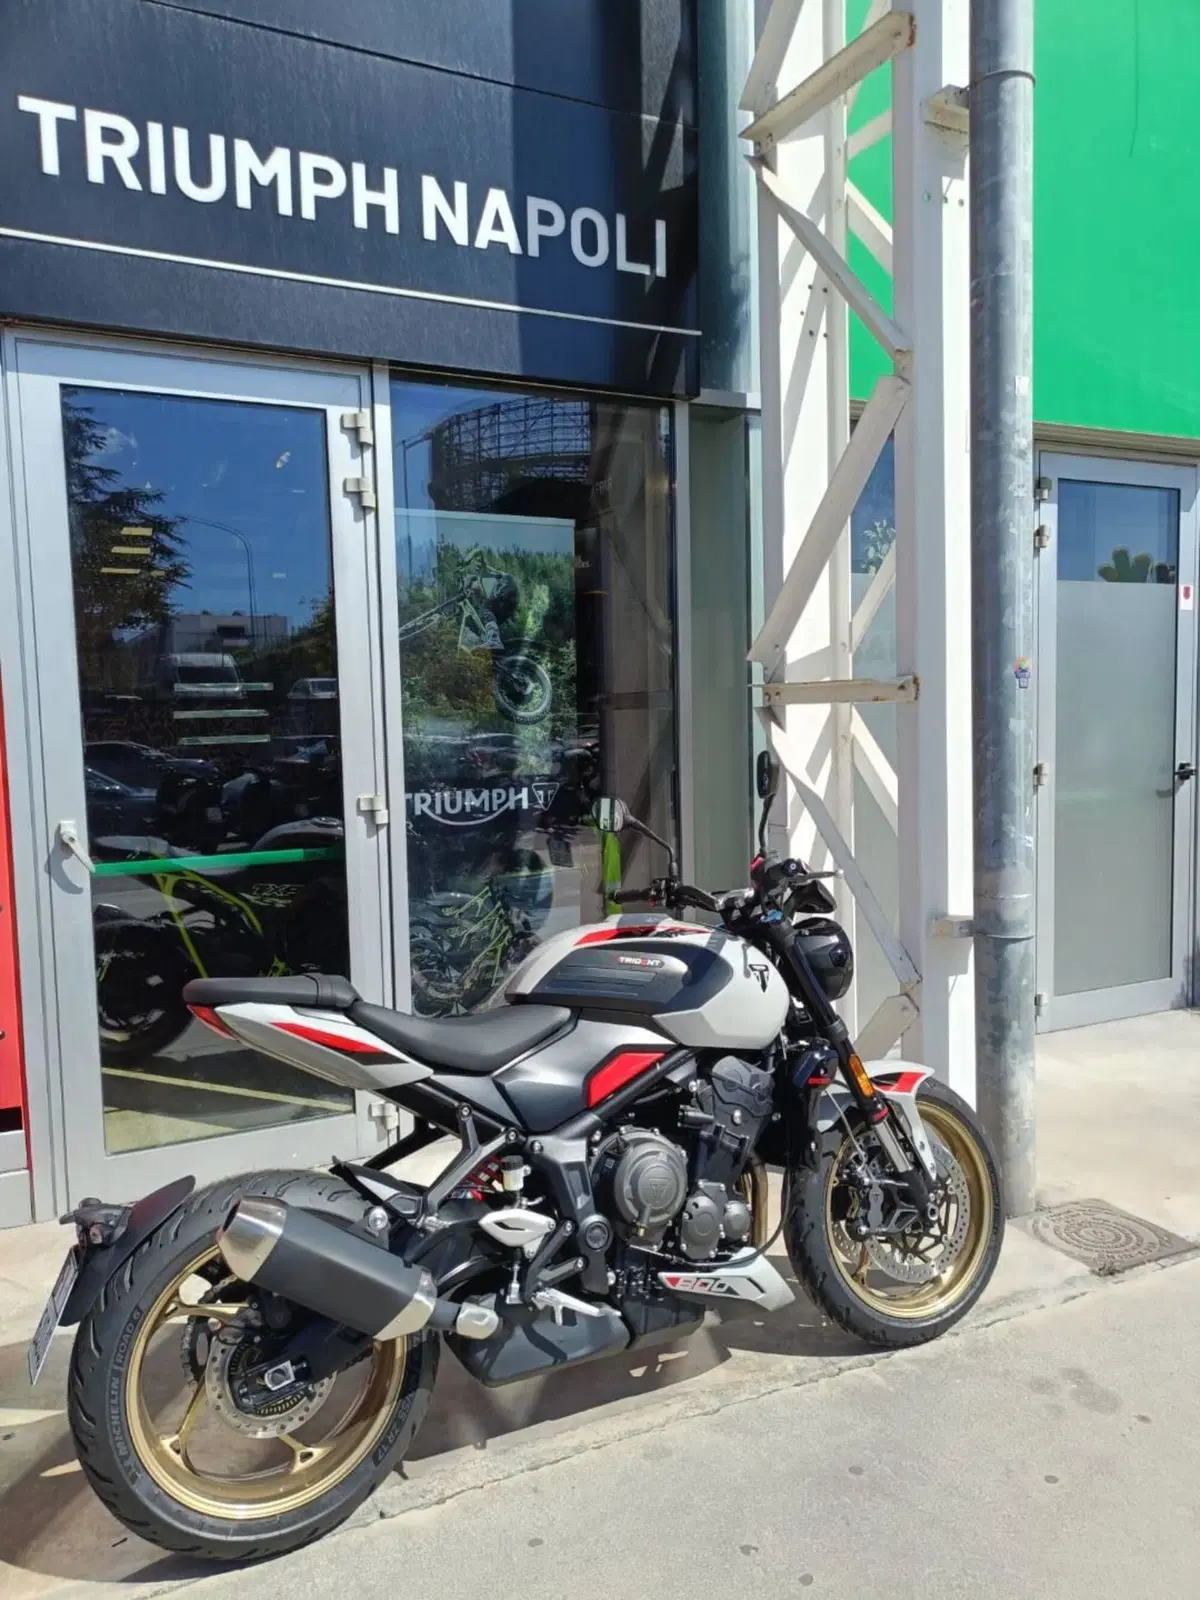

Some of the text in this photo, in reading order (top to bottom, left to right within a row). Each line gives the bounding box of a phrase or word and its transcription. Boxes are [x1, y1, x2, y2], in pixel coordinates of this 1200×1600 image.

[18, 95, 667, 278] TRIUMPH NAPOLI
[116, 1323, 135, 1364] ROAD
[110, 1376, 128, 1456] MICHELIN
